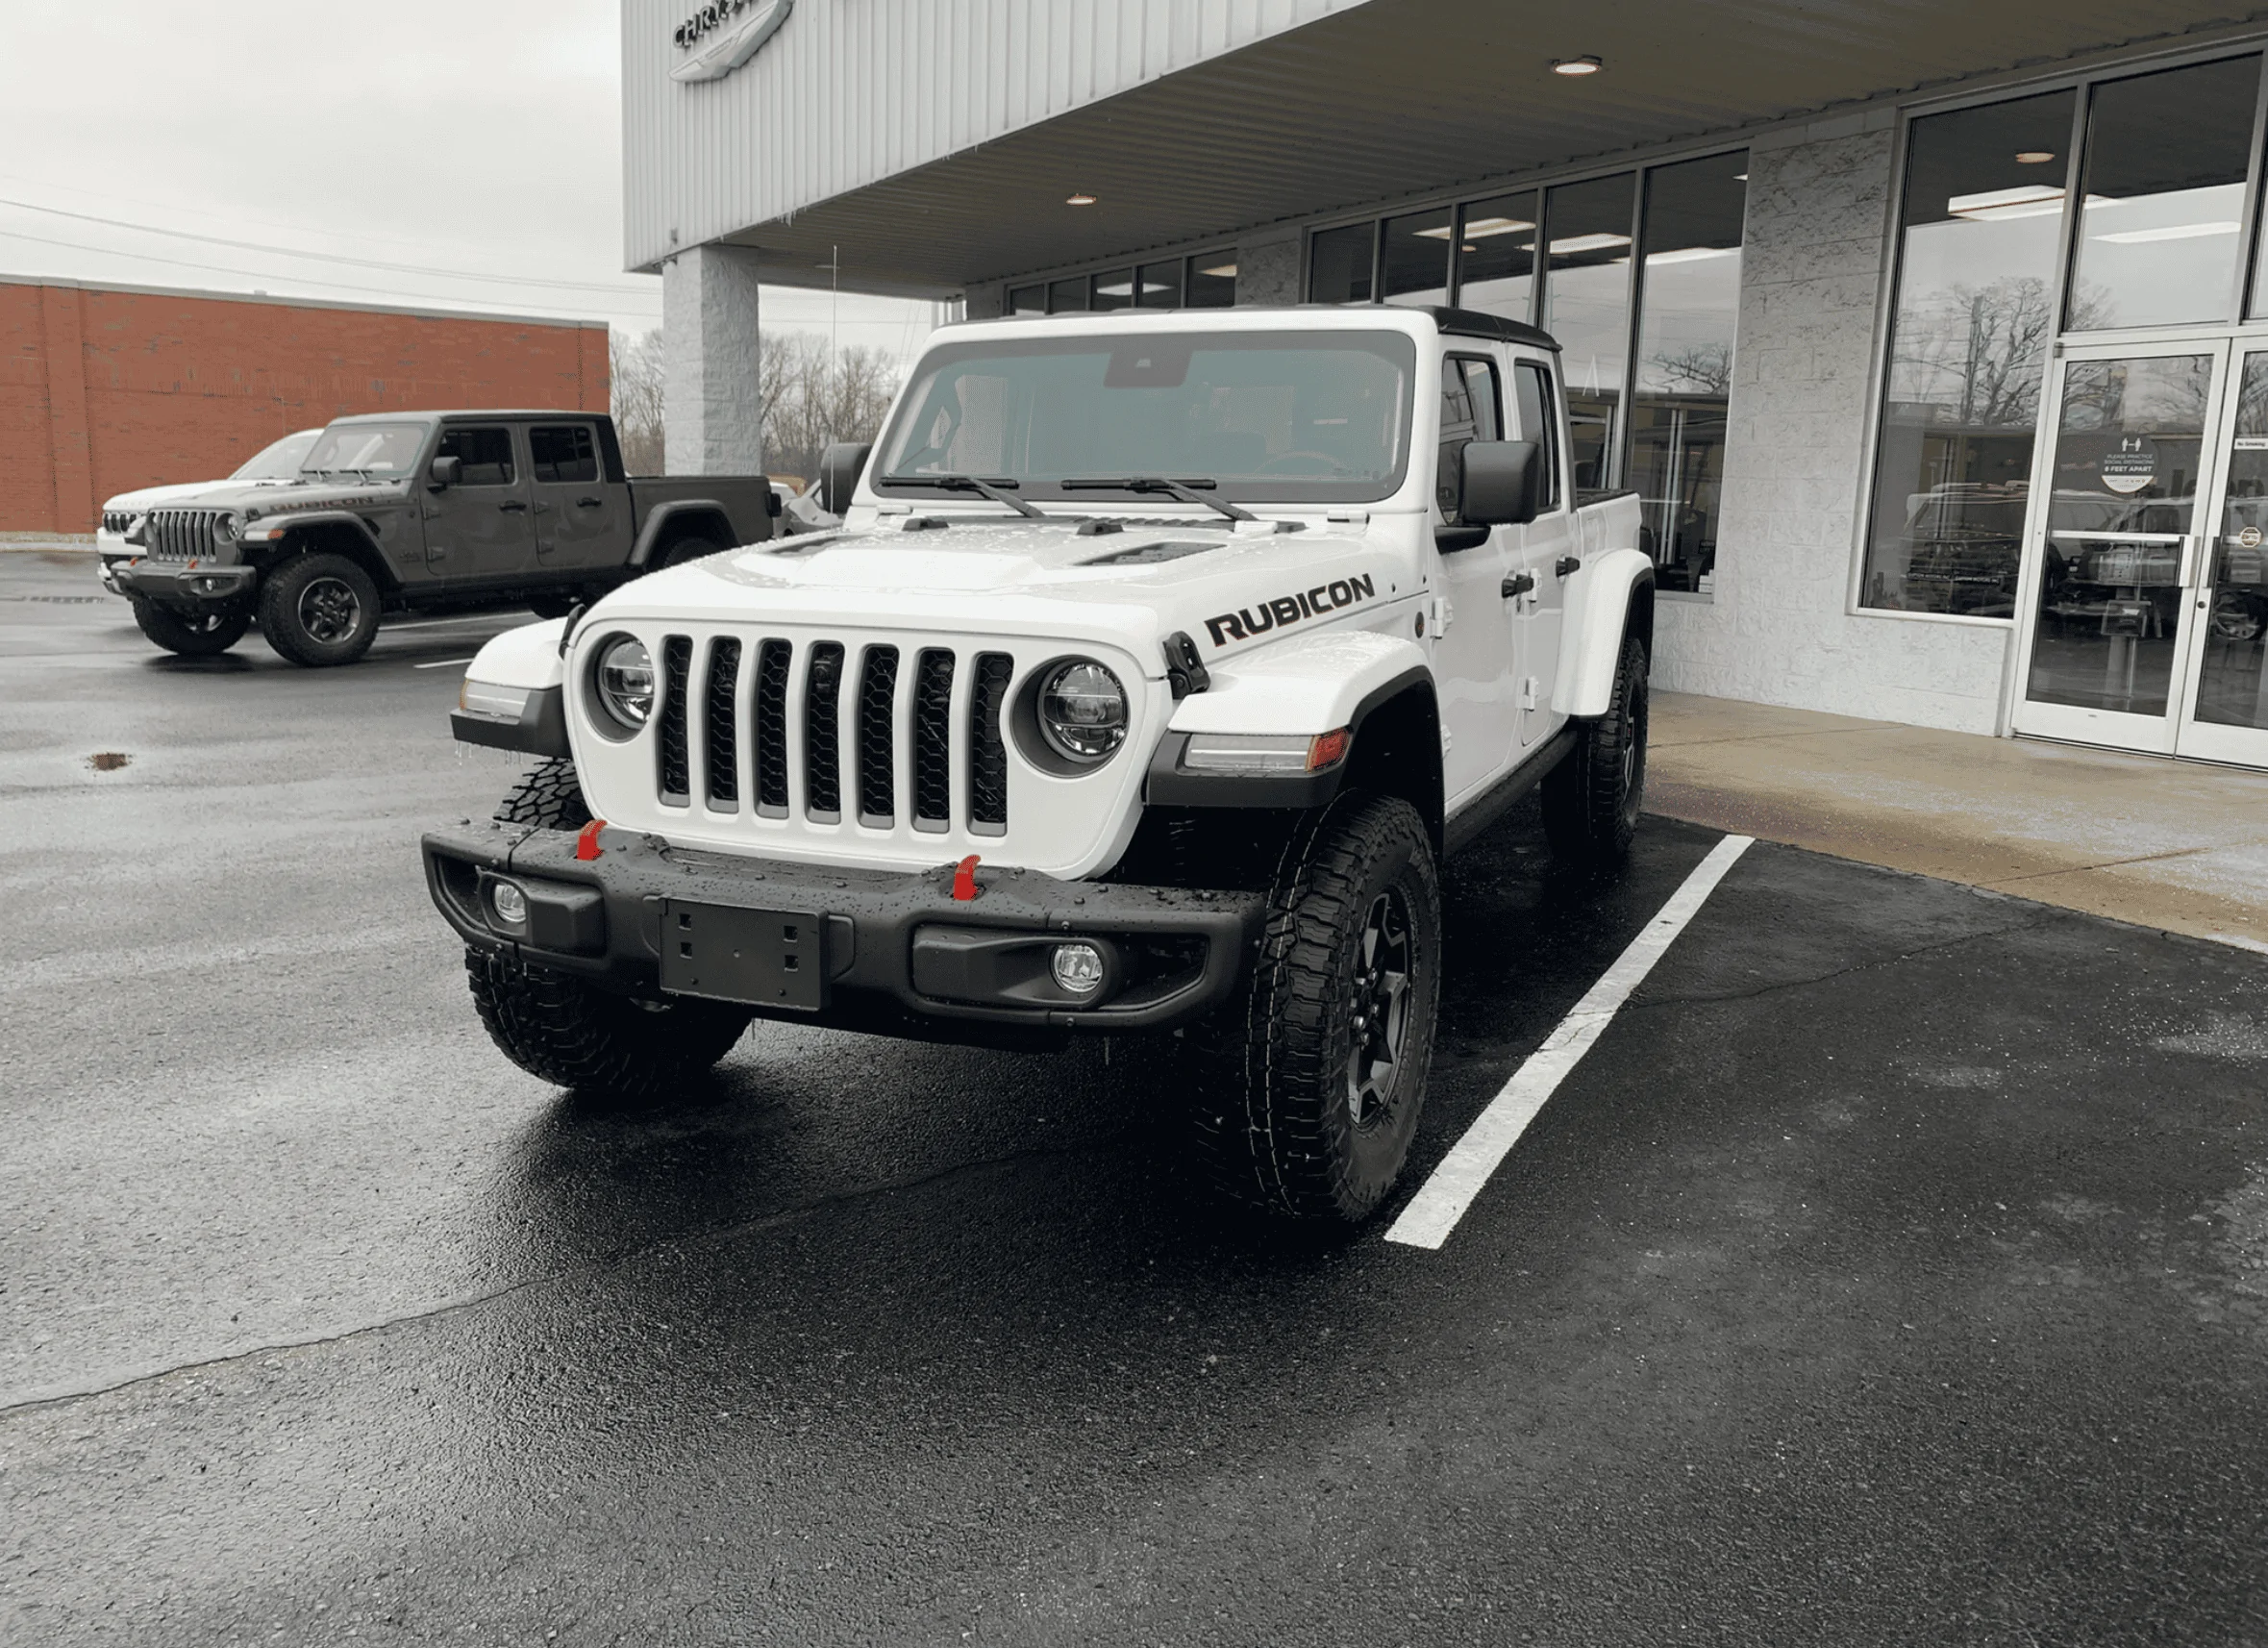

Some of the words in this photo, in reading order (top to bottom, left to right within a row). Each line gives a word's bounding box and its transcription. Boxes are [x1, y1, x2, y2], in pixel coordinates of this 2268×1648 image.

[672, 0, 746, 47] CHRYS
[269, 496, 374, 512] RUBICON
[1204, 573, 1375, 647] RUBICON
